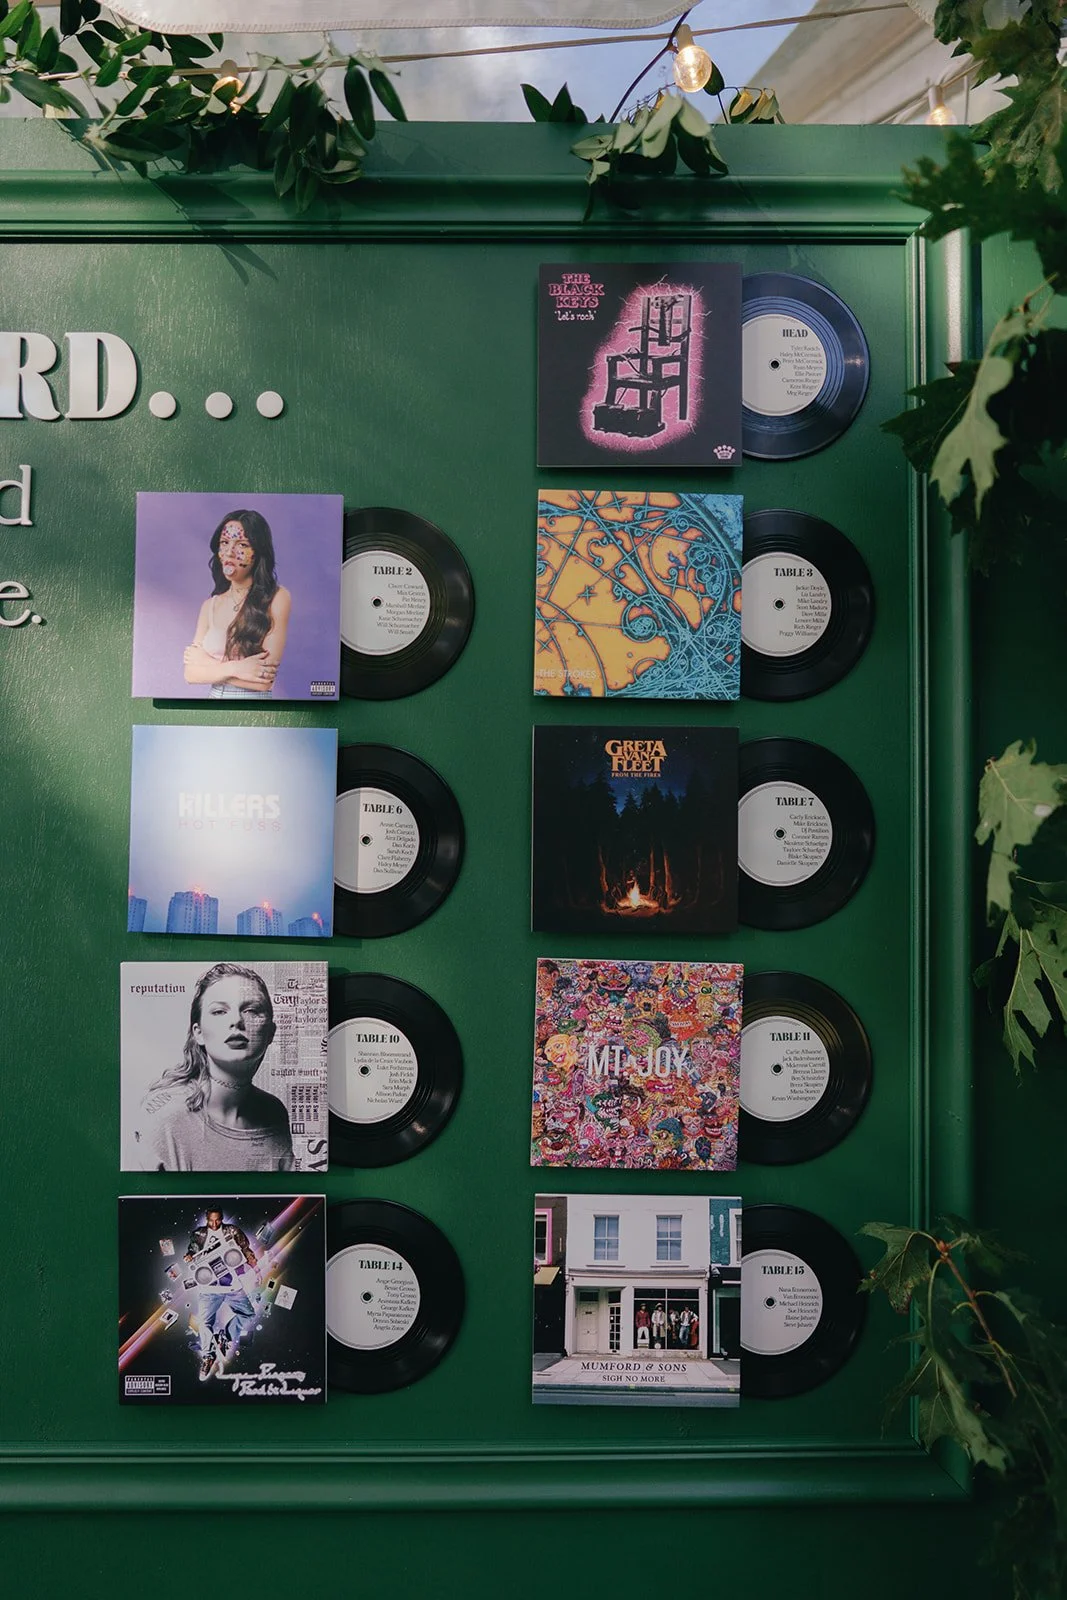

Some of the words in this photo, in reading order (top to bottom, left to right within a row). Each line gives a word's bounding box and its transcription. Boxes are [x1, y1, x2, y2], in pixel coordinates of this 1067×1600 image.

[562, 273, 590, 284] THE
[548, 284, 605, 296] BLACK
[556, 296, 599, 308] KEYS
[783, 329, 808, 337] HEAD
[373, 566, 404, 575] TABLE
[774, 568, 804, 576] TABLE
[807, 568, 813, 576] 3
[539, 669, 556, 677] THE
[559, 670, 596, 678] STROKES
[605, 740, 668, 756] GRETA
[623, 752, 650, 760] VAN
[611, 756, 664, 771] FLEET
[179, 793, 280, 818] KILLERS
[775, 797, 806, 806] TABLE
[808, 797, 814, 806] 7
[363, 803, 394, 813] TABLE
[396, 806, 402, 814] 6
[179, 820, 217, 831] HOT
[230, 820, 282, 832] FUSS
[131, 984, 185, 995] reputation
[356, 1034, 387, 1043] TABLE
[390, 1035, 399, 1043] 10
[770, 1032, 801, 1041] TABLE
[803, 1032, 810, 1040] 11
[639, 1046, 689, 1078] JOY
[359, 1260, 390, 1270] TABLE
[393, 1262, 403, 1270] 14
[761, 1266, 792, 1274] TABLE
[795, 1266, 804, 1274] 15
[581, 1362, 641, 1370] MUMFORD
